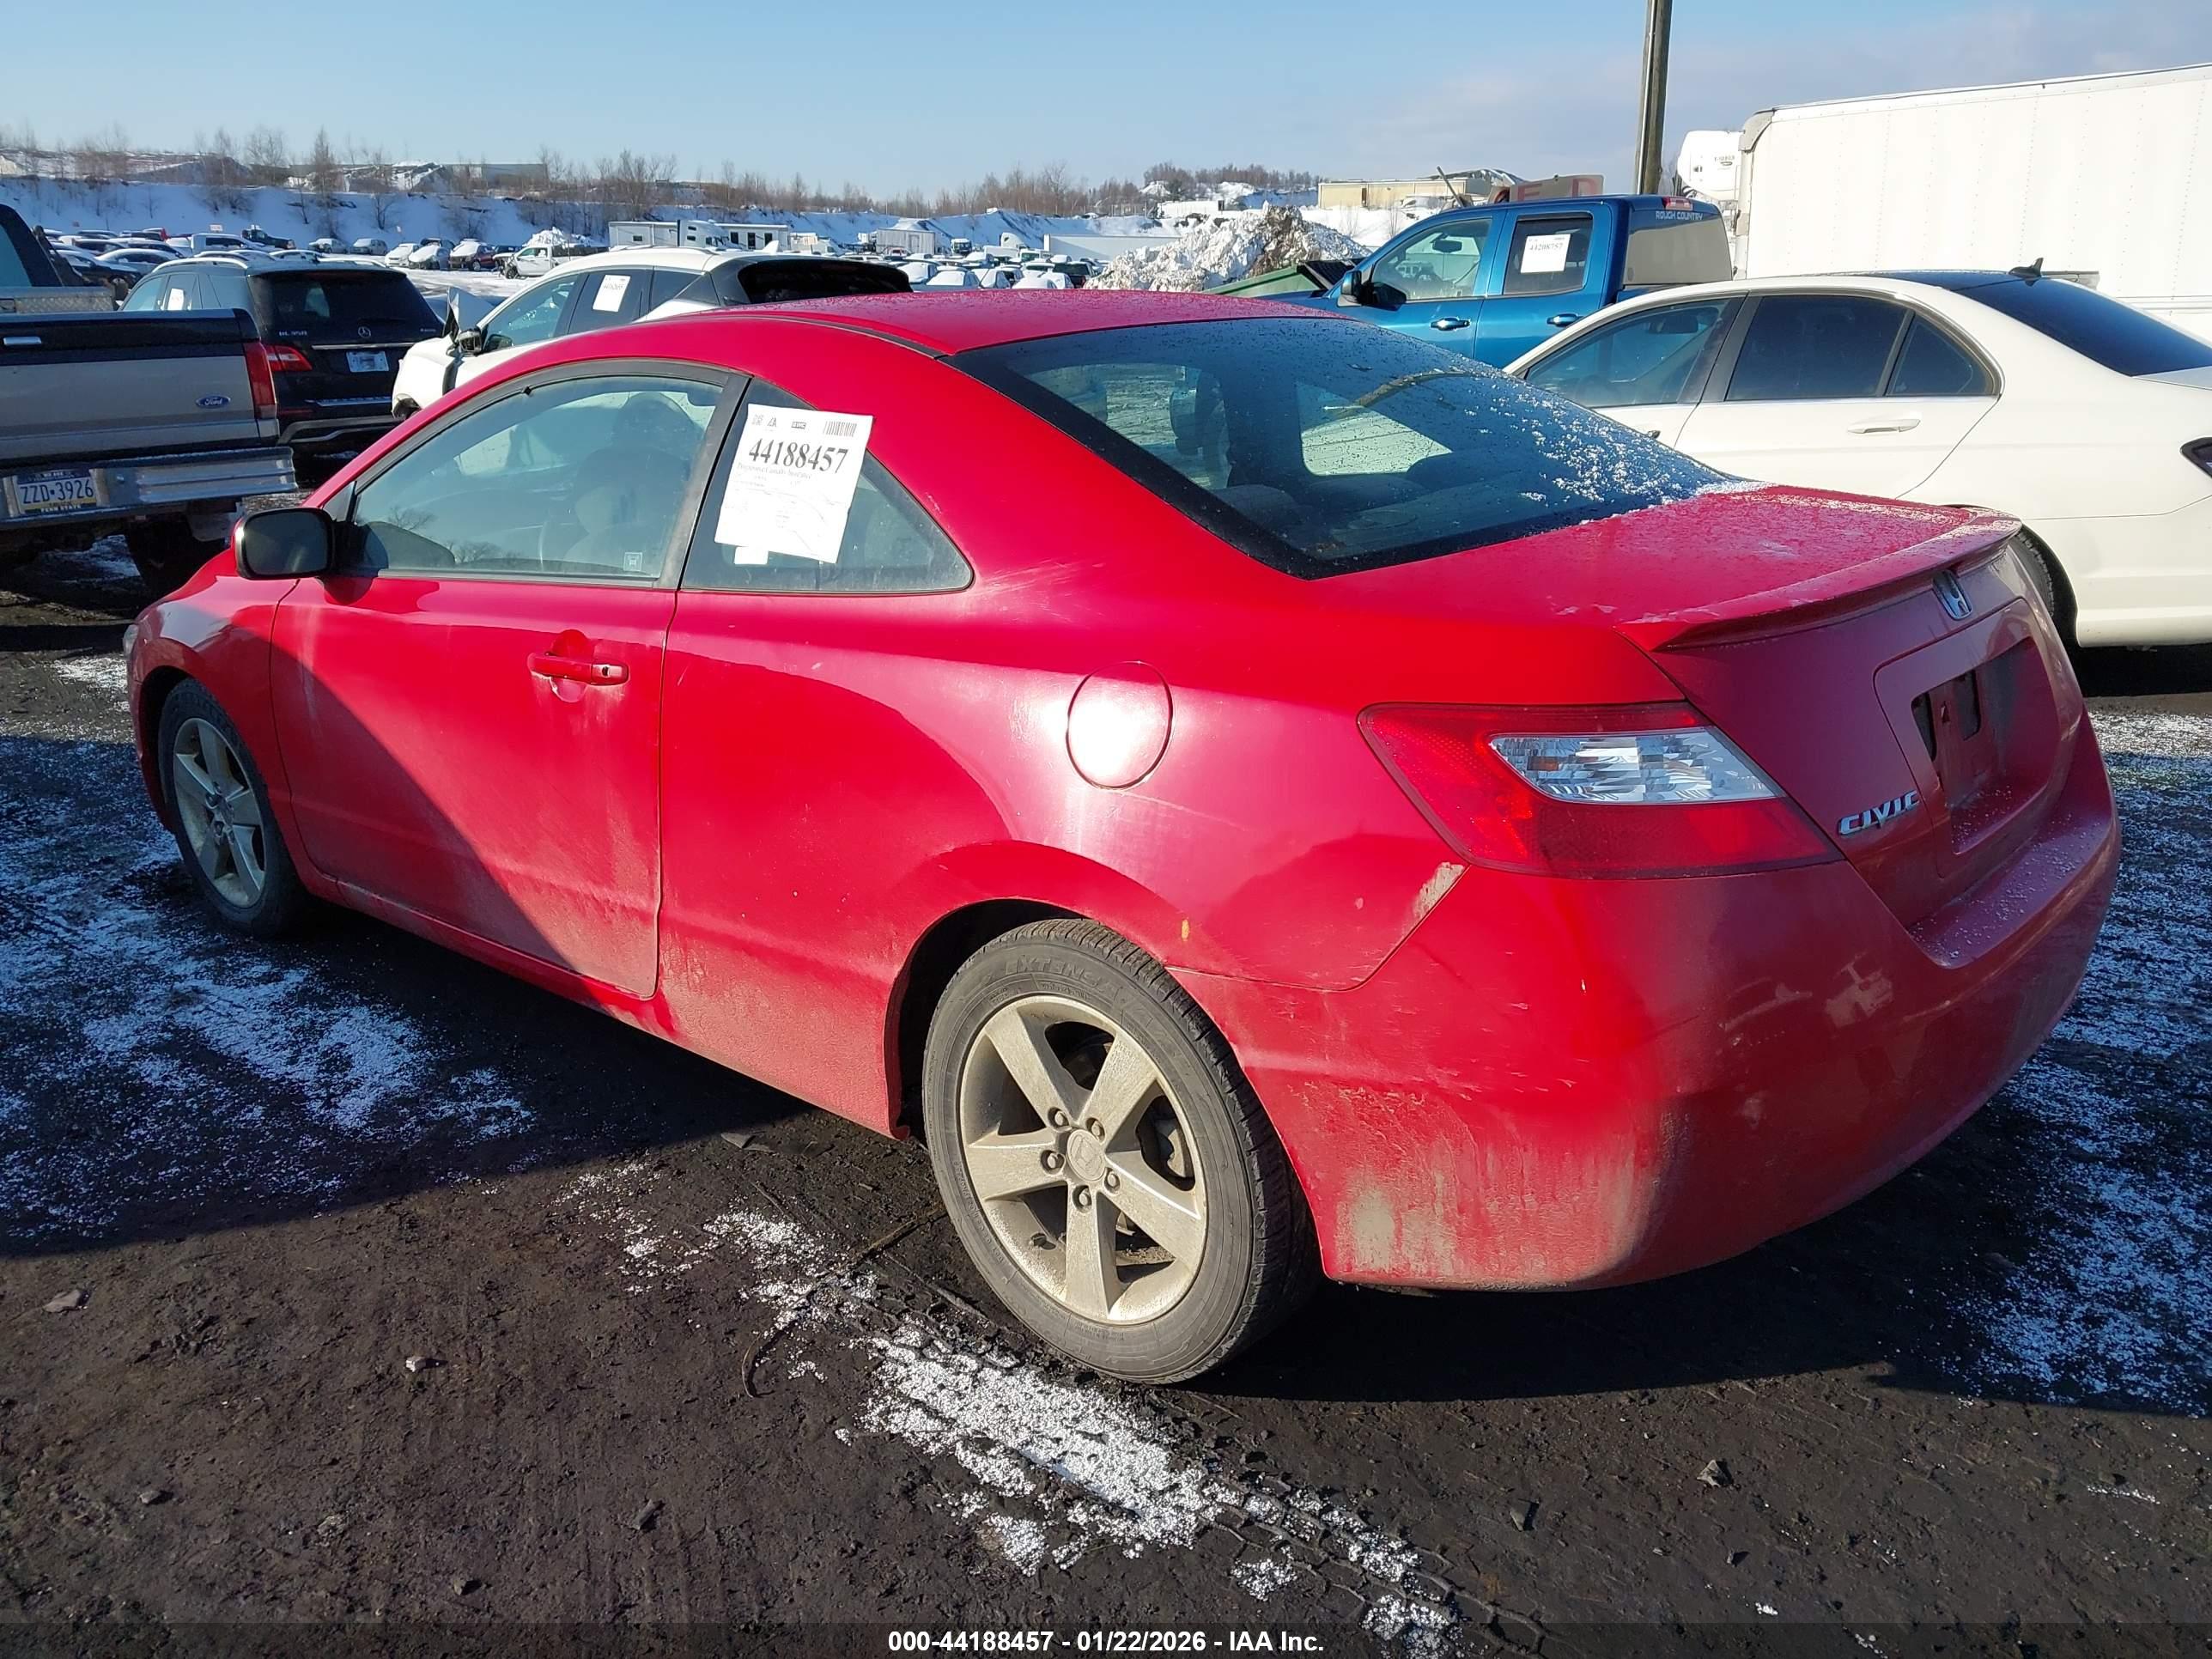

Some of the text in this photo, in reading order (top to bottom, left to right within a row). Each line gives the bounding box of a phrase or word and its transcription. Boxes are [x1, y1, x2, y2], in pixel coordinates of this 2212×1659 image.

[1656, 210, 1704, 221] ROUGH COUNTRY
[749, 438, 849, 474] 44188457
[1839, 790, 1920, 836] CIVIC
